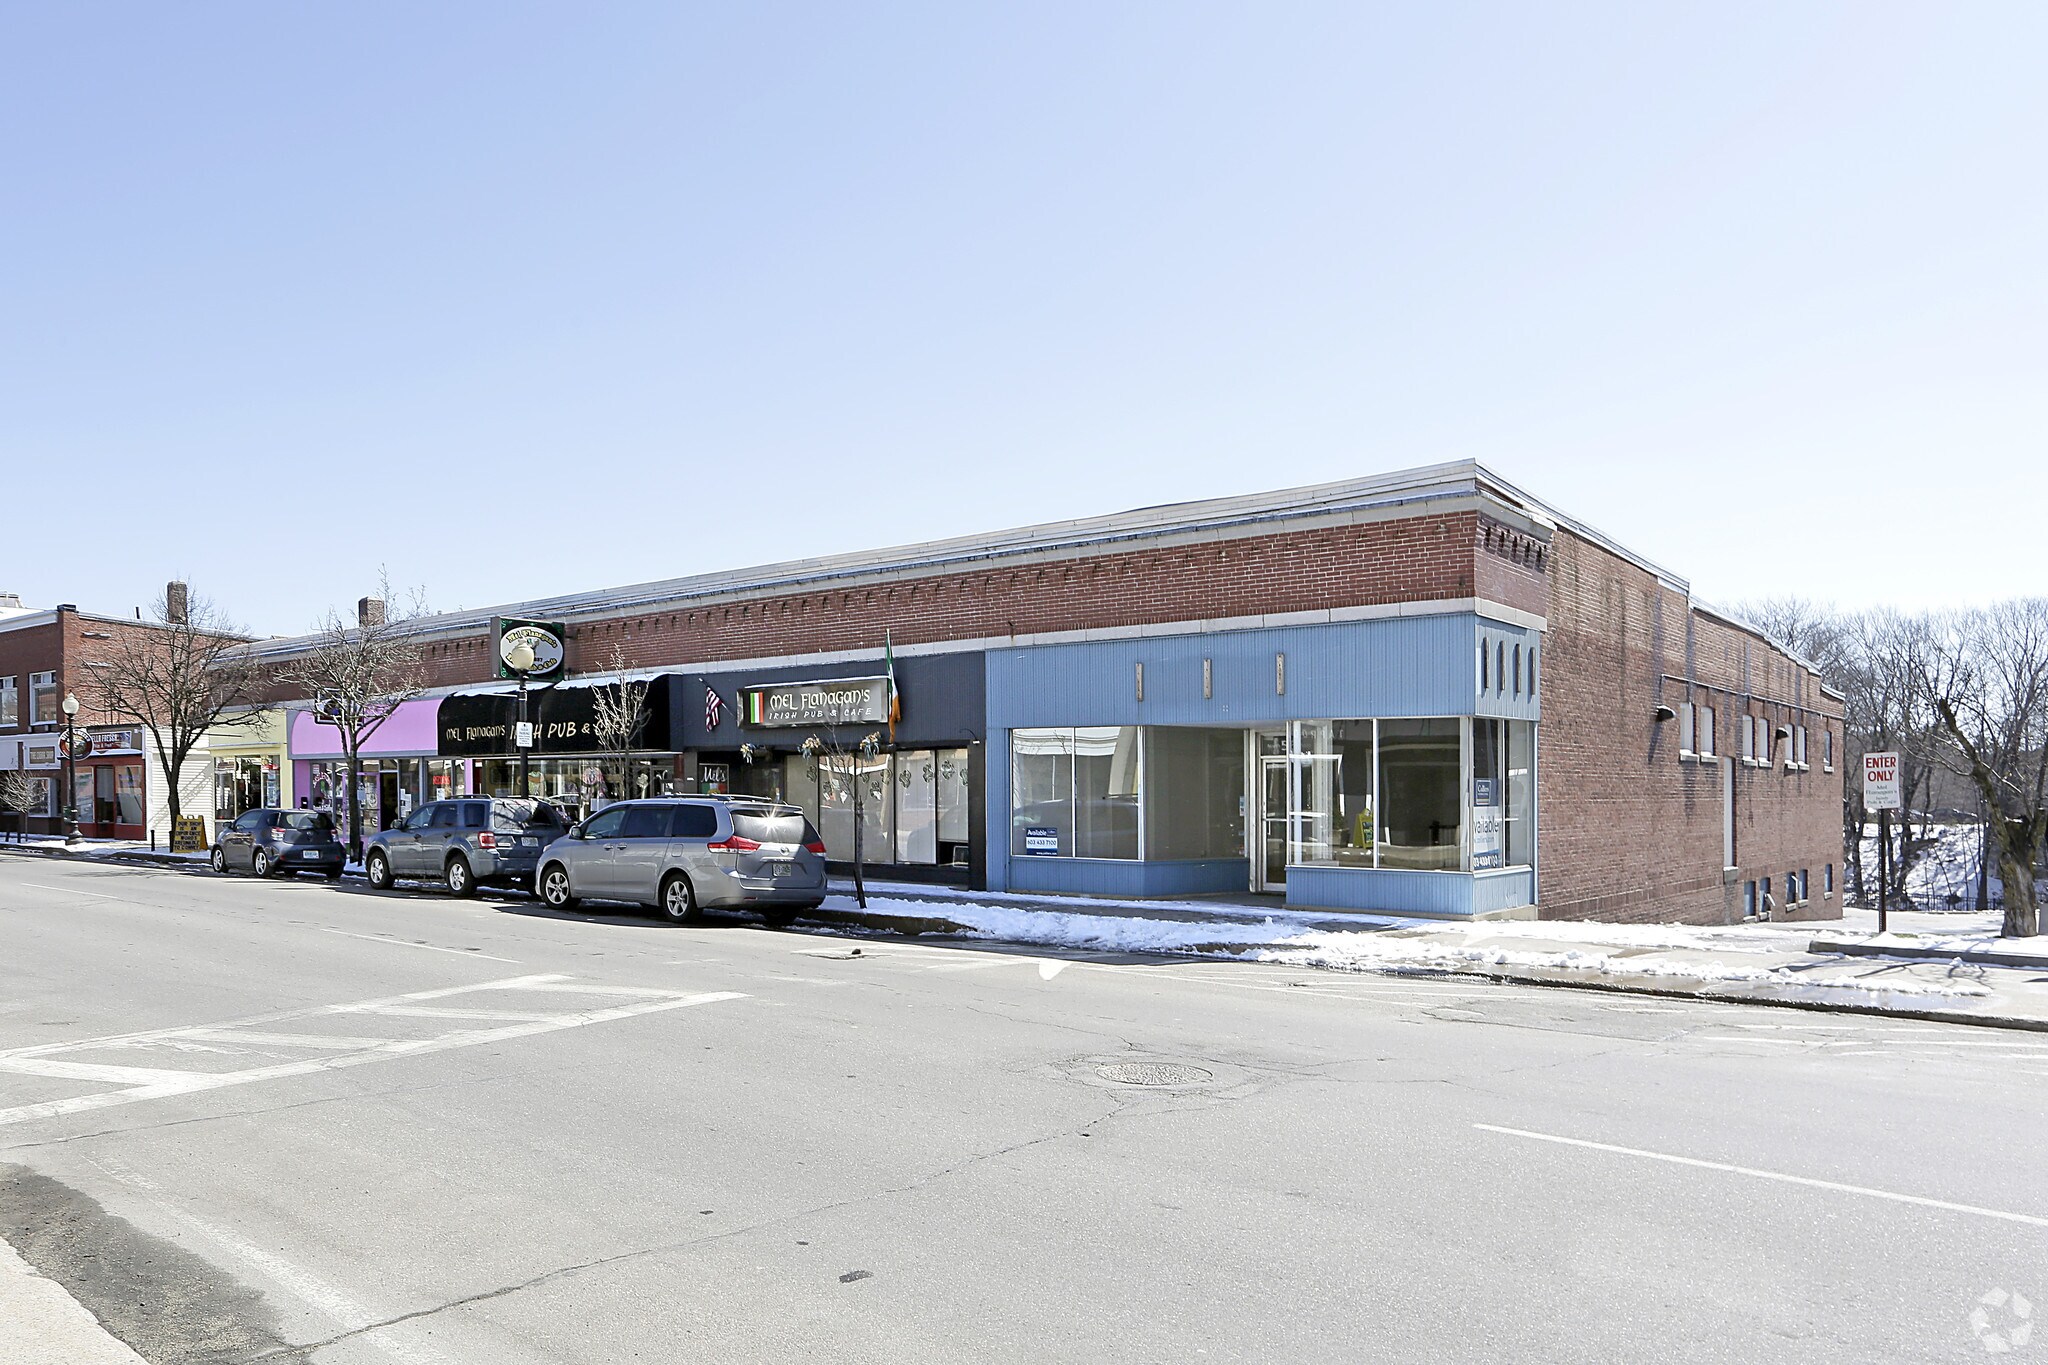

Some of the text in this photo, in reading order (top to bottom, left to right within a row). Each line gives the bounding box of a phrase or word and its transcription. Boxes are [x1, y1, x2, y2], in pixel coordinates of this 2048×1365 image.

[769, 707, 872, 720] IRISH PUB & CAFE
[547, 721, 577, 739] PUB
[581, 723, 591, 734] &
[1865, 755, 1897, 769] ENTER
[700, 766, 726, 783] Mel's
[1868, 770, 1894, 782] ONLY
[1474, 815, 1499, 834] vailable
